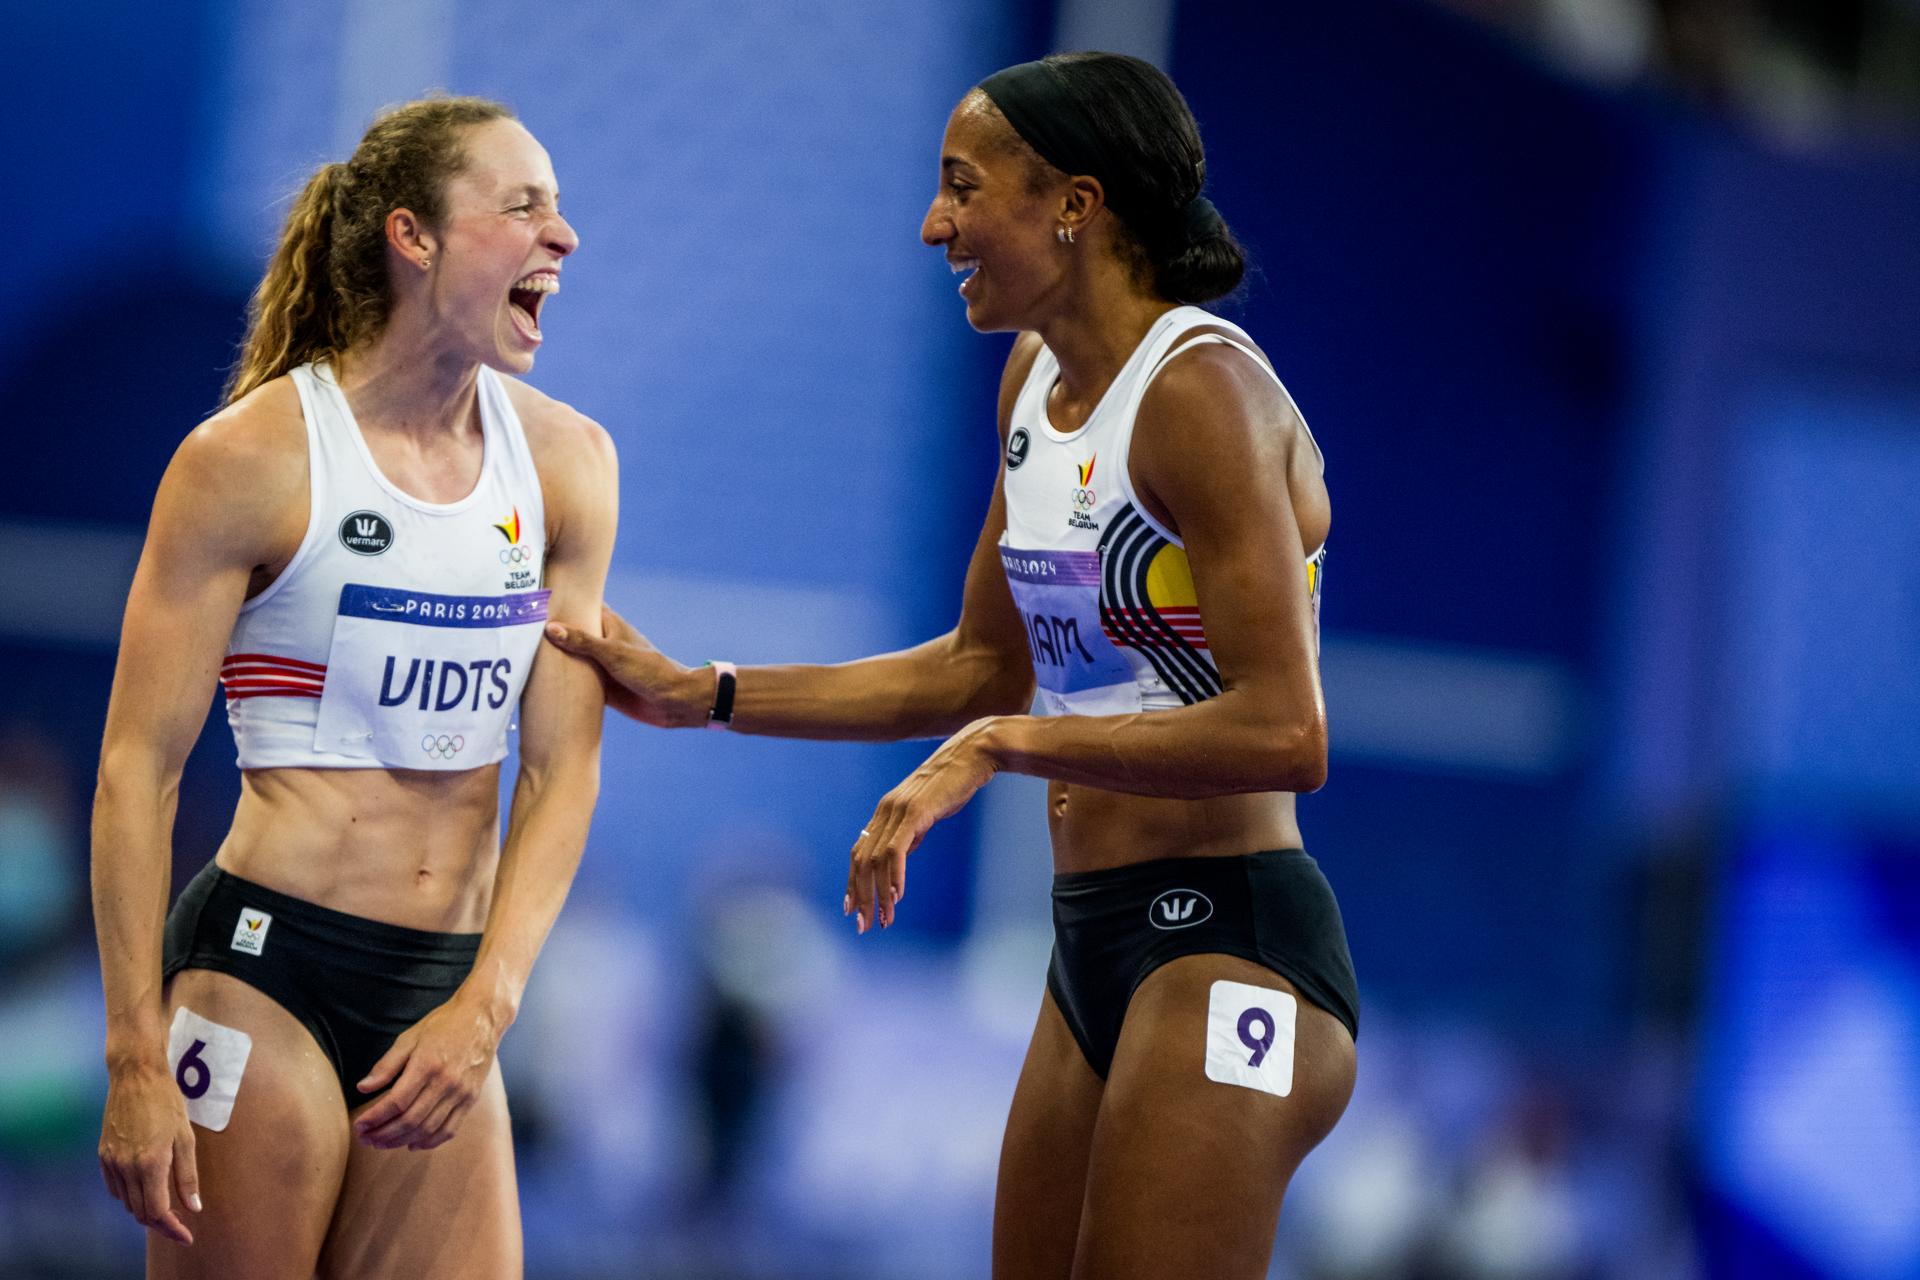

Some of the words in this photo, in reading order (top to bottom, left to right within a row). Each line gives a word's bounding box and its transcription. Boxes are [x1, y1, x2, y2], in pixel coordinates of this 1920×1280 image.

[1073, 511, 1091, 521] TEAM
[1068, 518, 1100, 531] BELGIUM
[346, 536, 385, 547] vermarc
[1022, 560, 1056, 575] 2024
[510, 571, 530, 580] TEAM
[504, 578, 536, 589] BELGIUM
[472, 603, 511, 620] 2024
[1237, 1007, 1276, 1068] 9
[176, 1038, 211, 1100] 6
